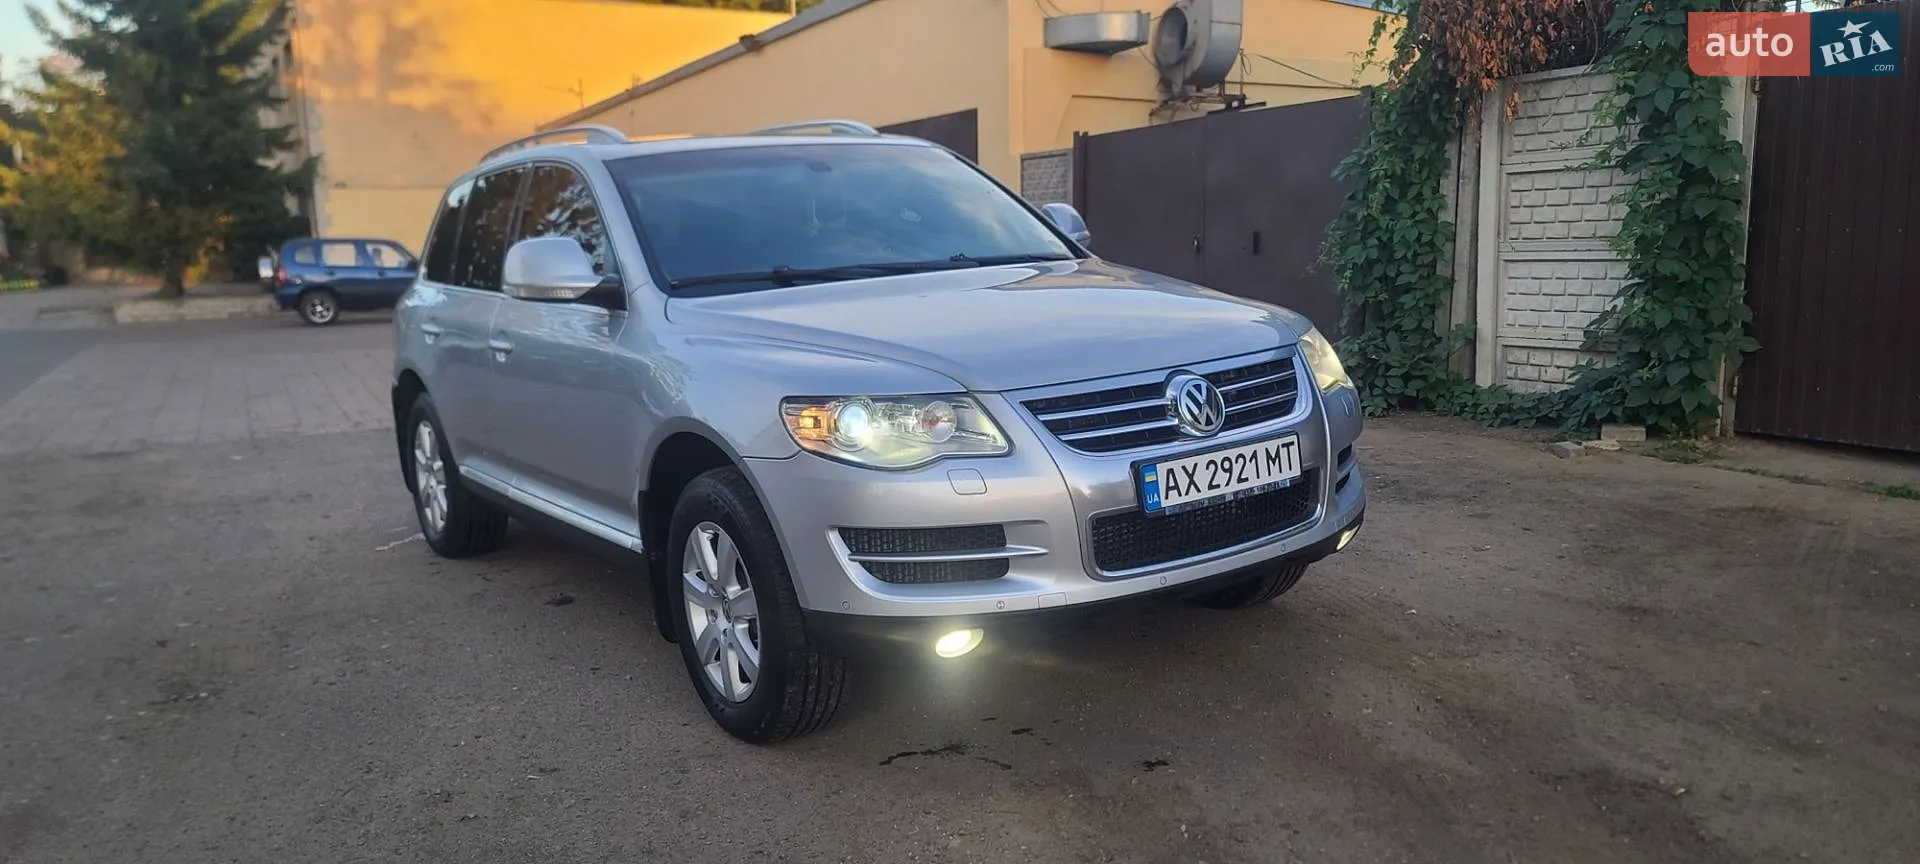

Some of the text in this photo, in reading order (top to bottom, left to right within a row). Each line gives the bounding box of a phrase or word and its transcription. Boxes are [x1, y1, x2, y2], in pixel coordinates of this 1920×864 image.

[1164, 462, 1202, 500] AX
[1205, 450, 1260, 491] 2921
[1264, 440, 1295, 477] MT
[1147, 494, 1160, 504] UA
